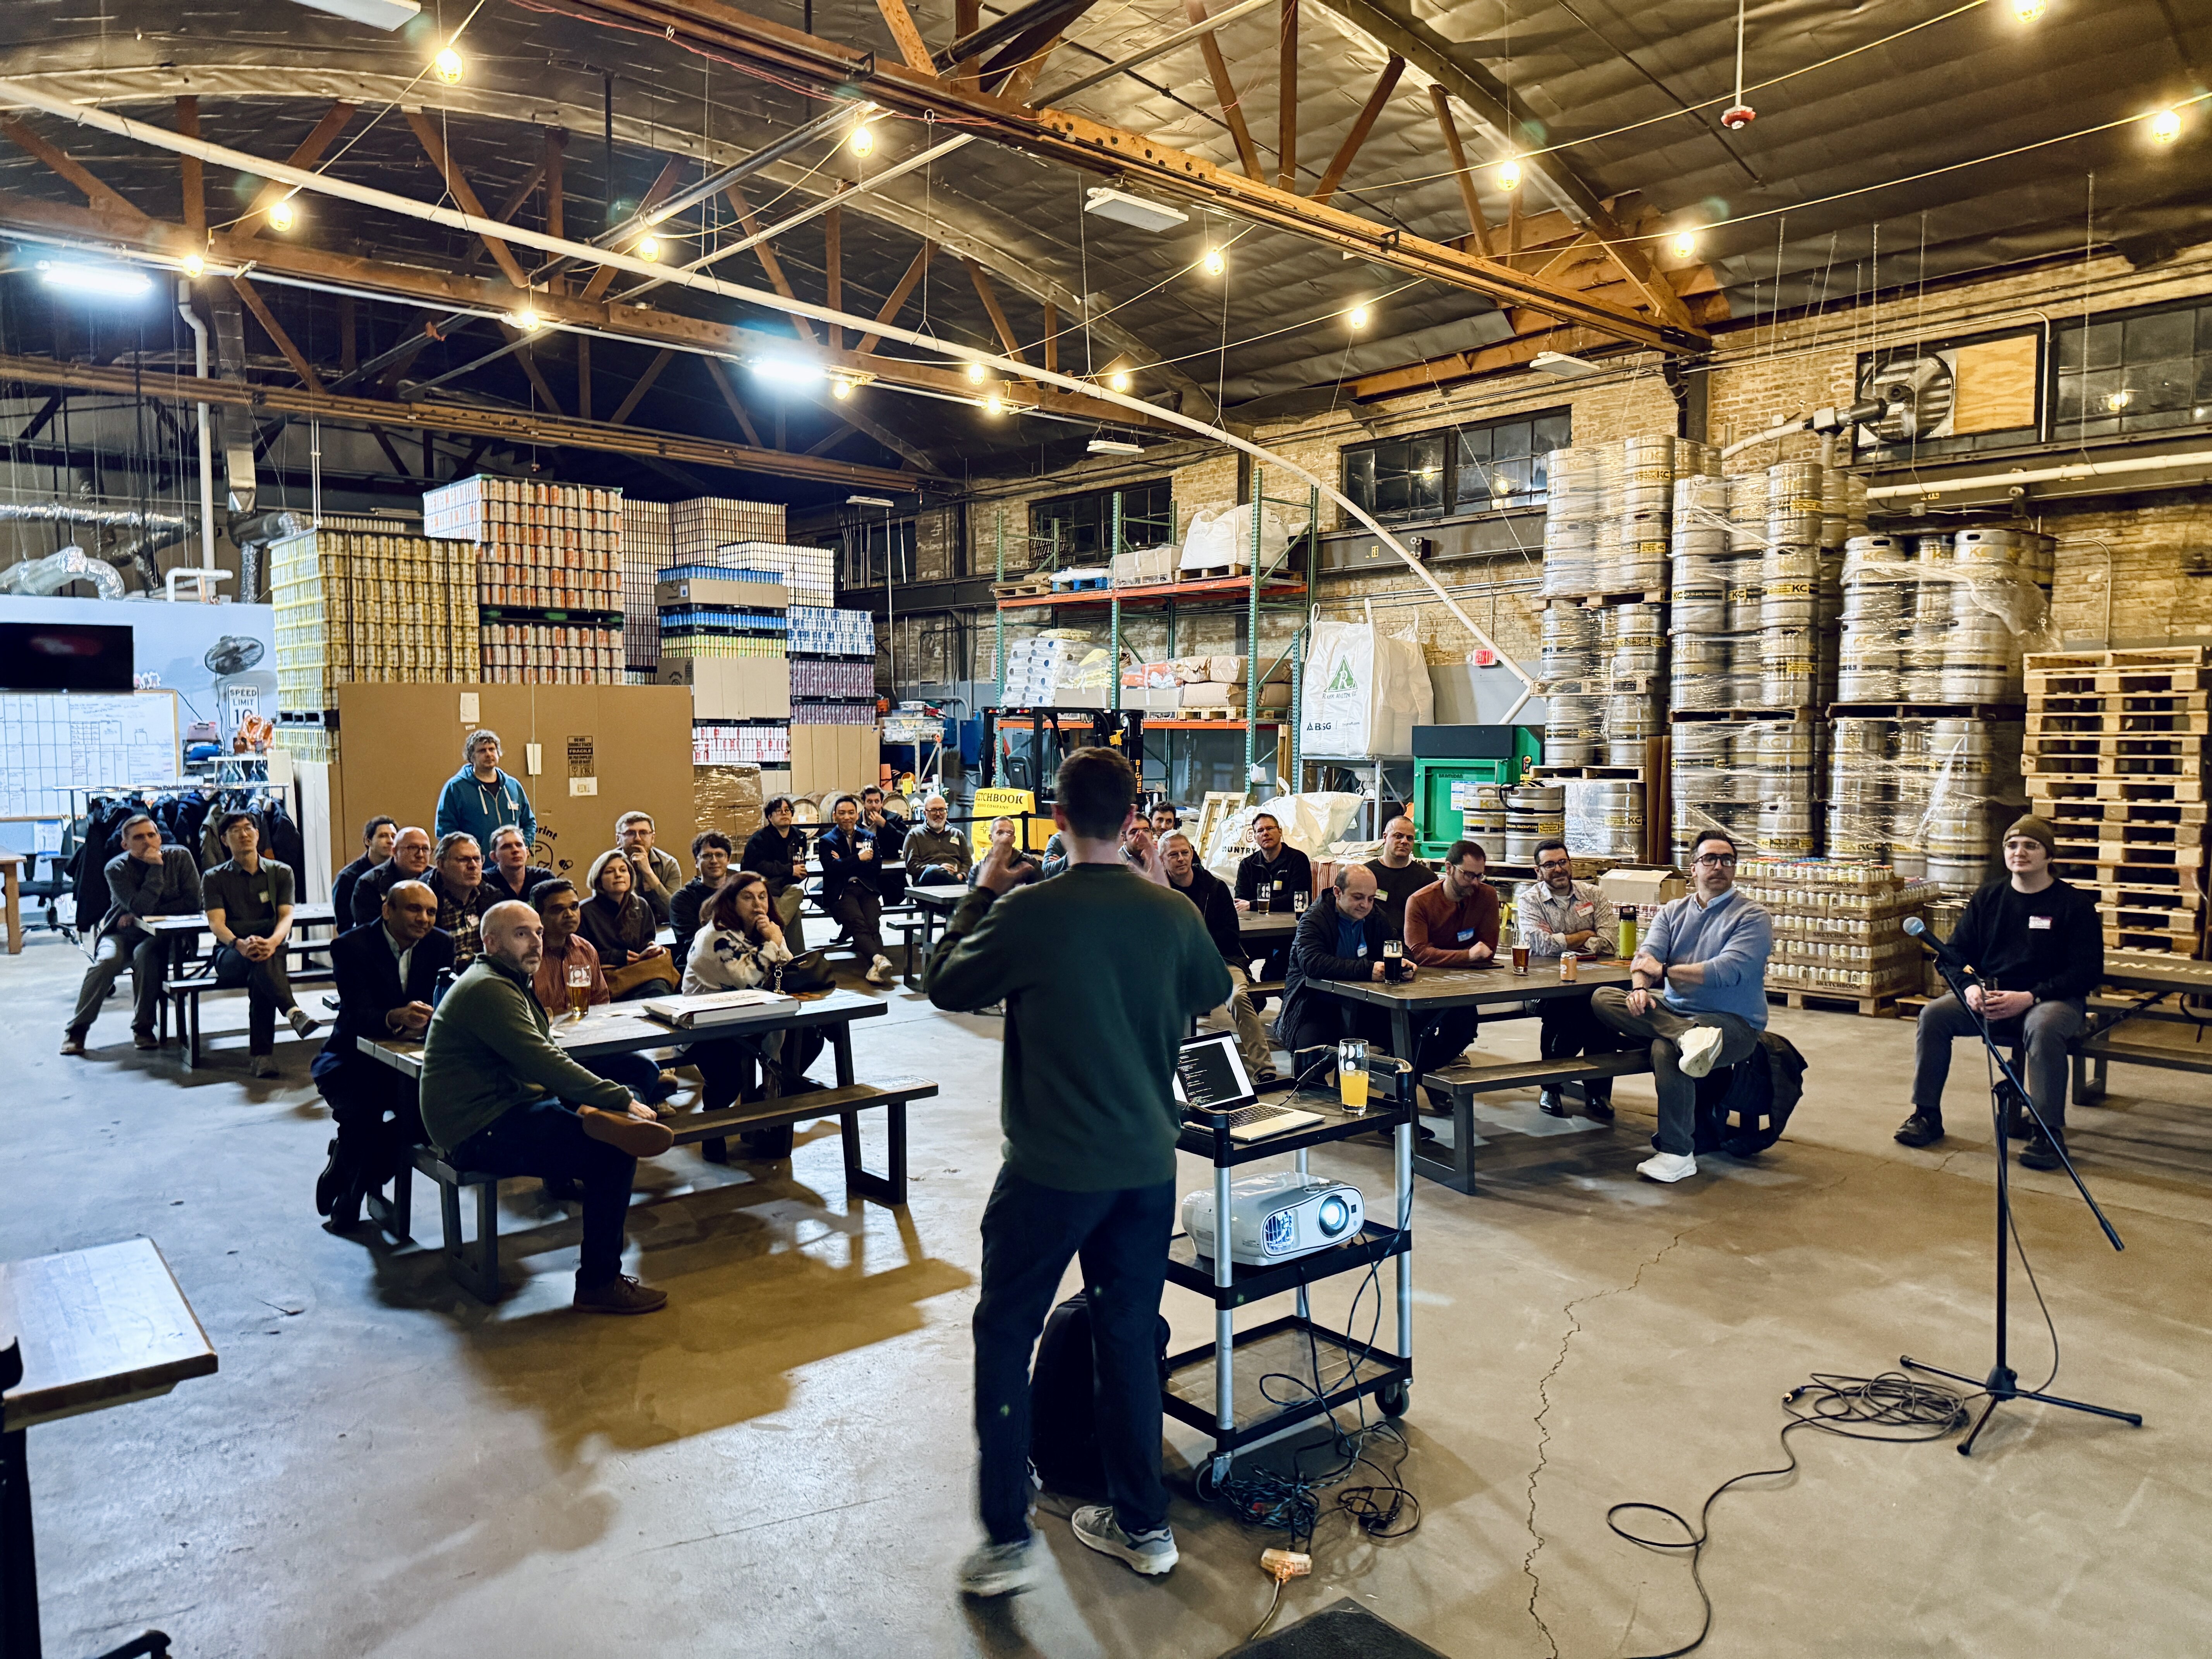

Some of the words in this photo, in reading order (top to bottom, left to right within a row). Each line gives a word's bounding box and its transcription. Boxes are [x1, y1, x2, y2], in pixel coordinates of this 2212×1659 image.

[1657, 471, 1669, 479] KC
[1673, 591, 1683, 600] KC
[1815, 980, 1861, 990] SKETCHBOOK
